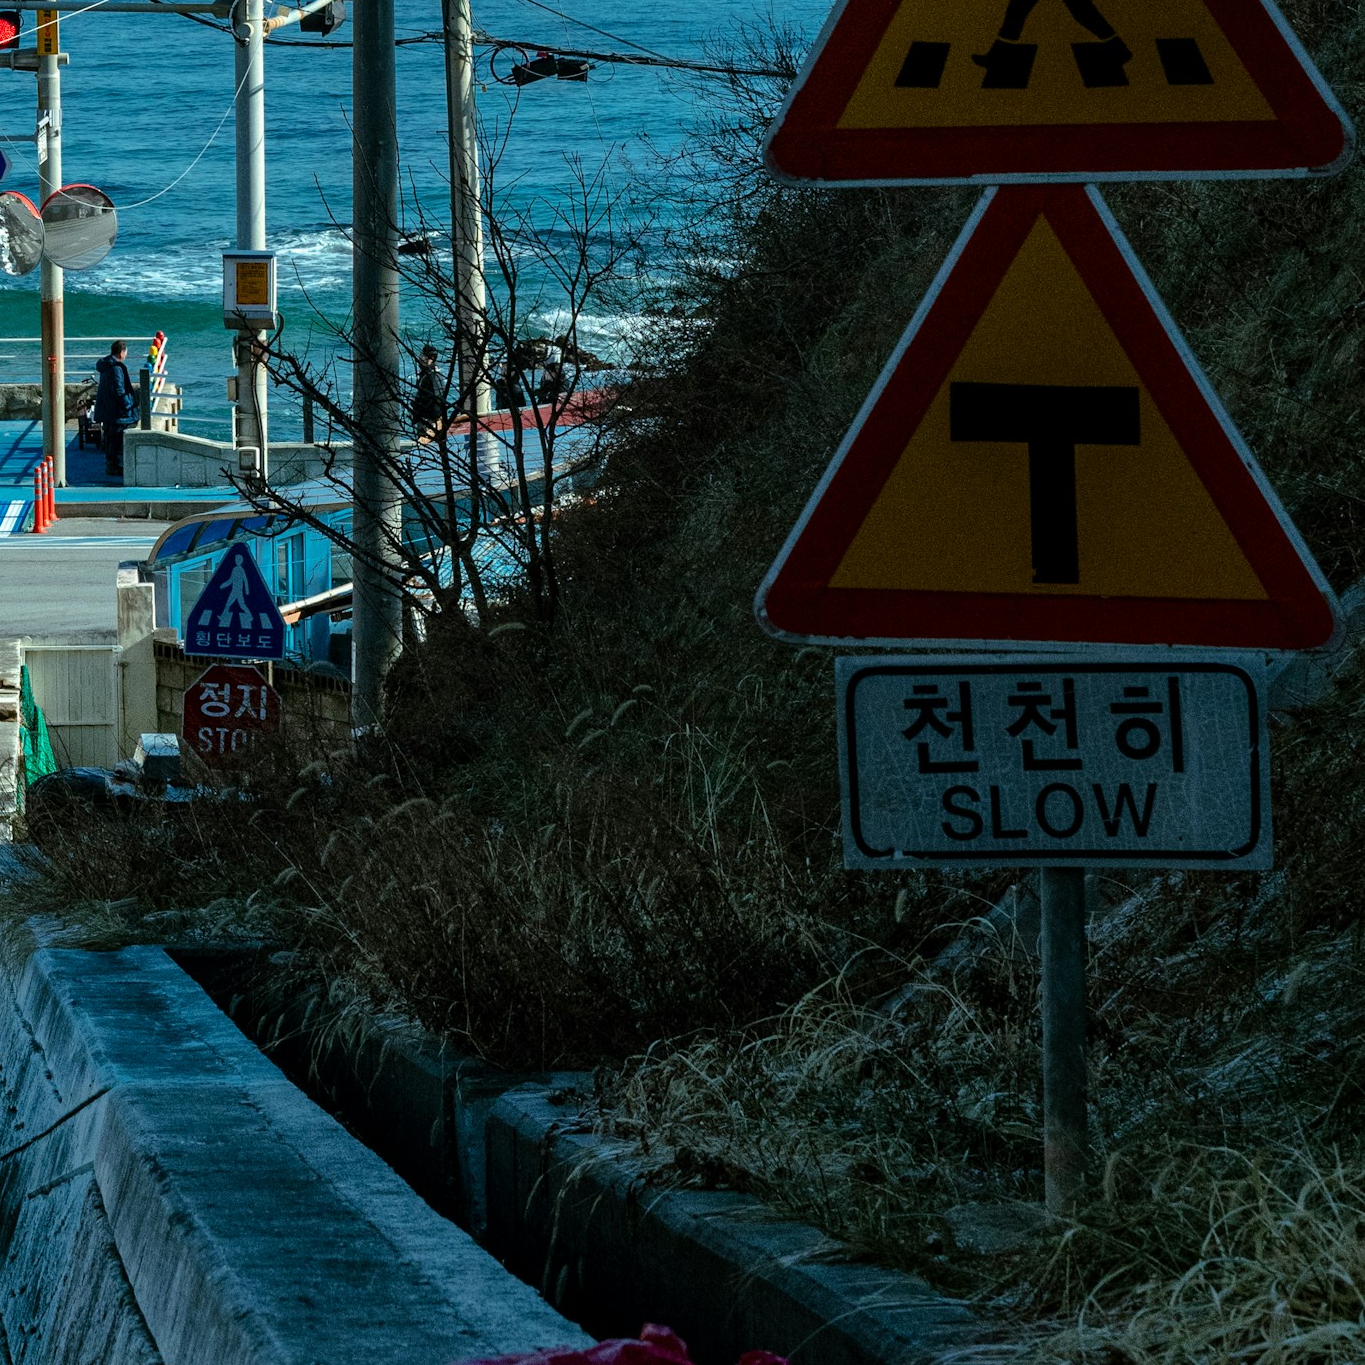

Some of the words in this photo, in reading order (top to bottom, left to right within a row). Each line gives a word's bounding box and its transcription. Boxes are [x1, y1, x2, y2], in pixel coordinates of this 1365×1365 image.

[196, 631, 273, 648] 횡단보도
[199, 682, 267, 721] 정지
[198, 726, 255, 754] STO
[902, 675, 1185, 774] 천천히
[941, 782, 1158, 841] SLOW
